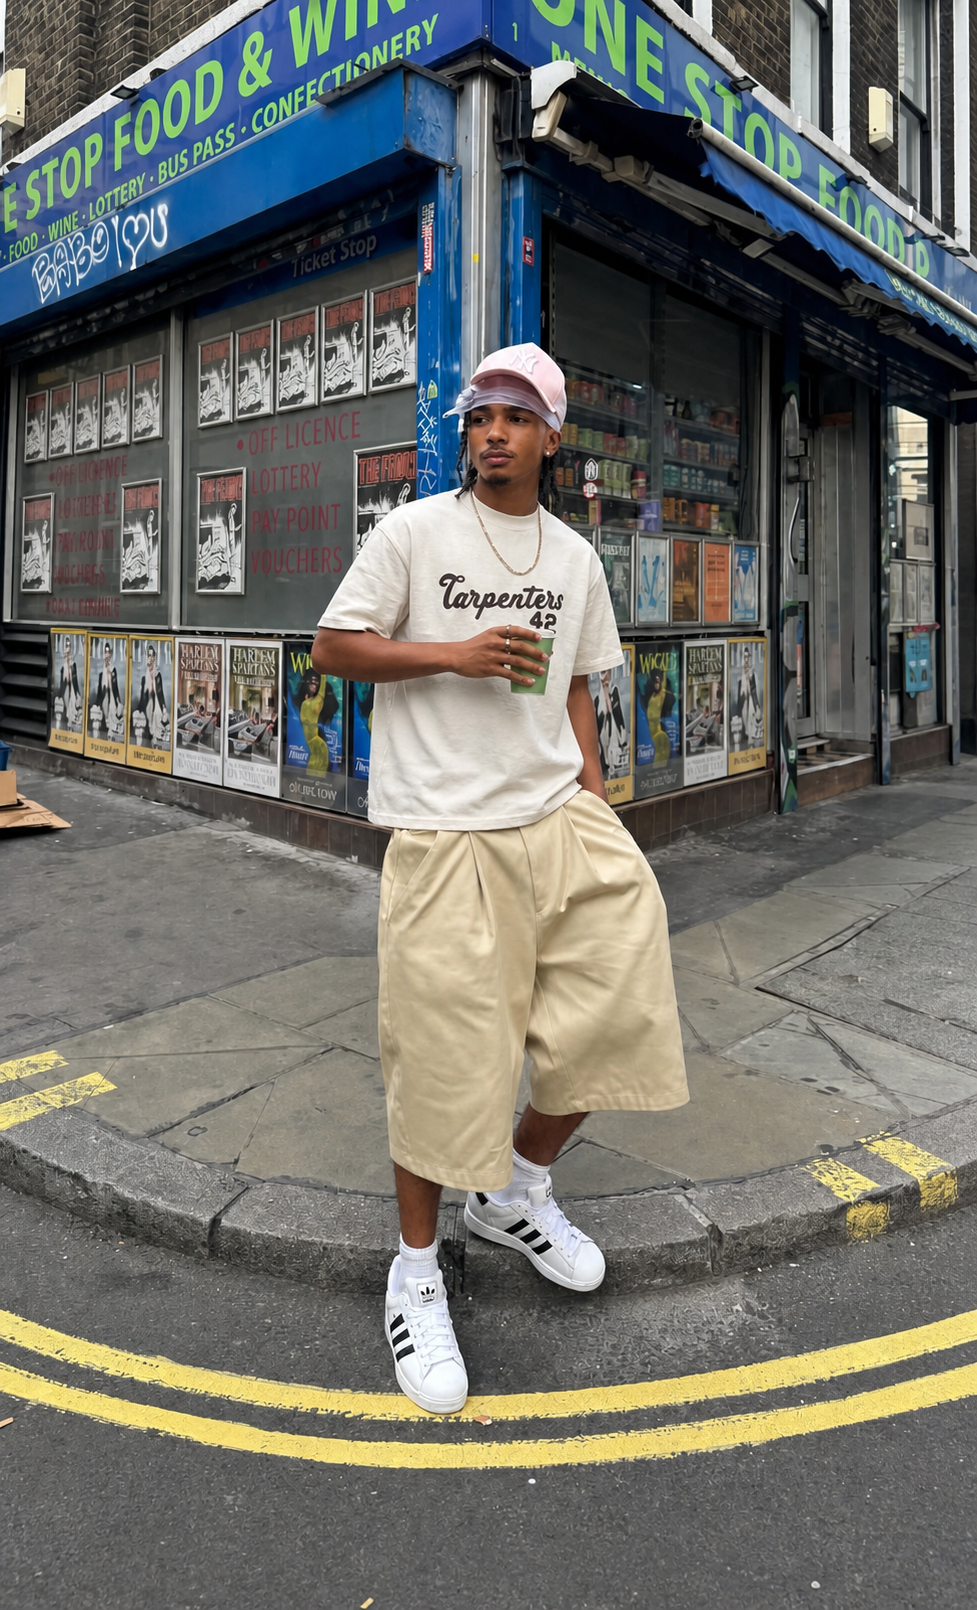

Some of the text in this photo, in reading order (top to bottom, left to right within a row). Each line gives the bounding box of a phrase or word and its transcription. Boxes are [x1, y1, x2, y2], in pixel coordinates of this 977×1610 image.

[9, 12, 439, 263] FOOD WINE LOTTERY BUS PASS CONFECTIONERY
[26, 132, 103, 221] STOP
[114, 60, 224, 171] FOOD
[238, 30, 273, 98] &
[684, 62, 802, 180] STOP
[819, 163, 905, 265] FOOD
[291, 246, 336, 278] Ticket
[340, 234, 378, 262] Stop
[248, 410, 361, 456] OFF LICENCE
[251, 461, 322, 495] LOTTERY
[251, 503, 341, 534] PAY POINT
[250, 546, 343, 574] VOUCHERS
[232, 647, 276, 664] HARLEM
